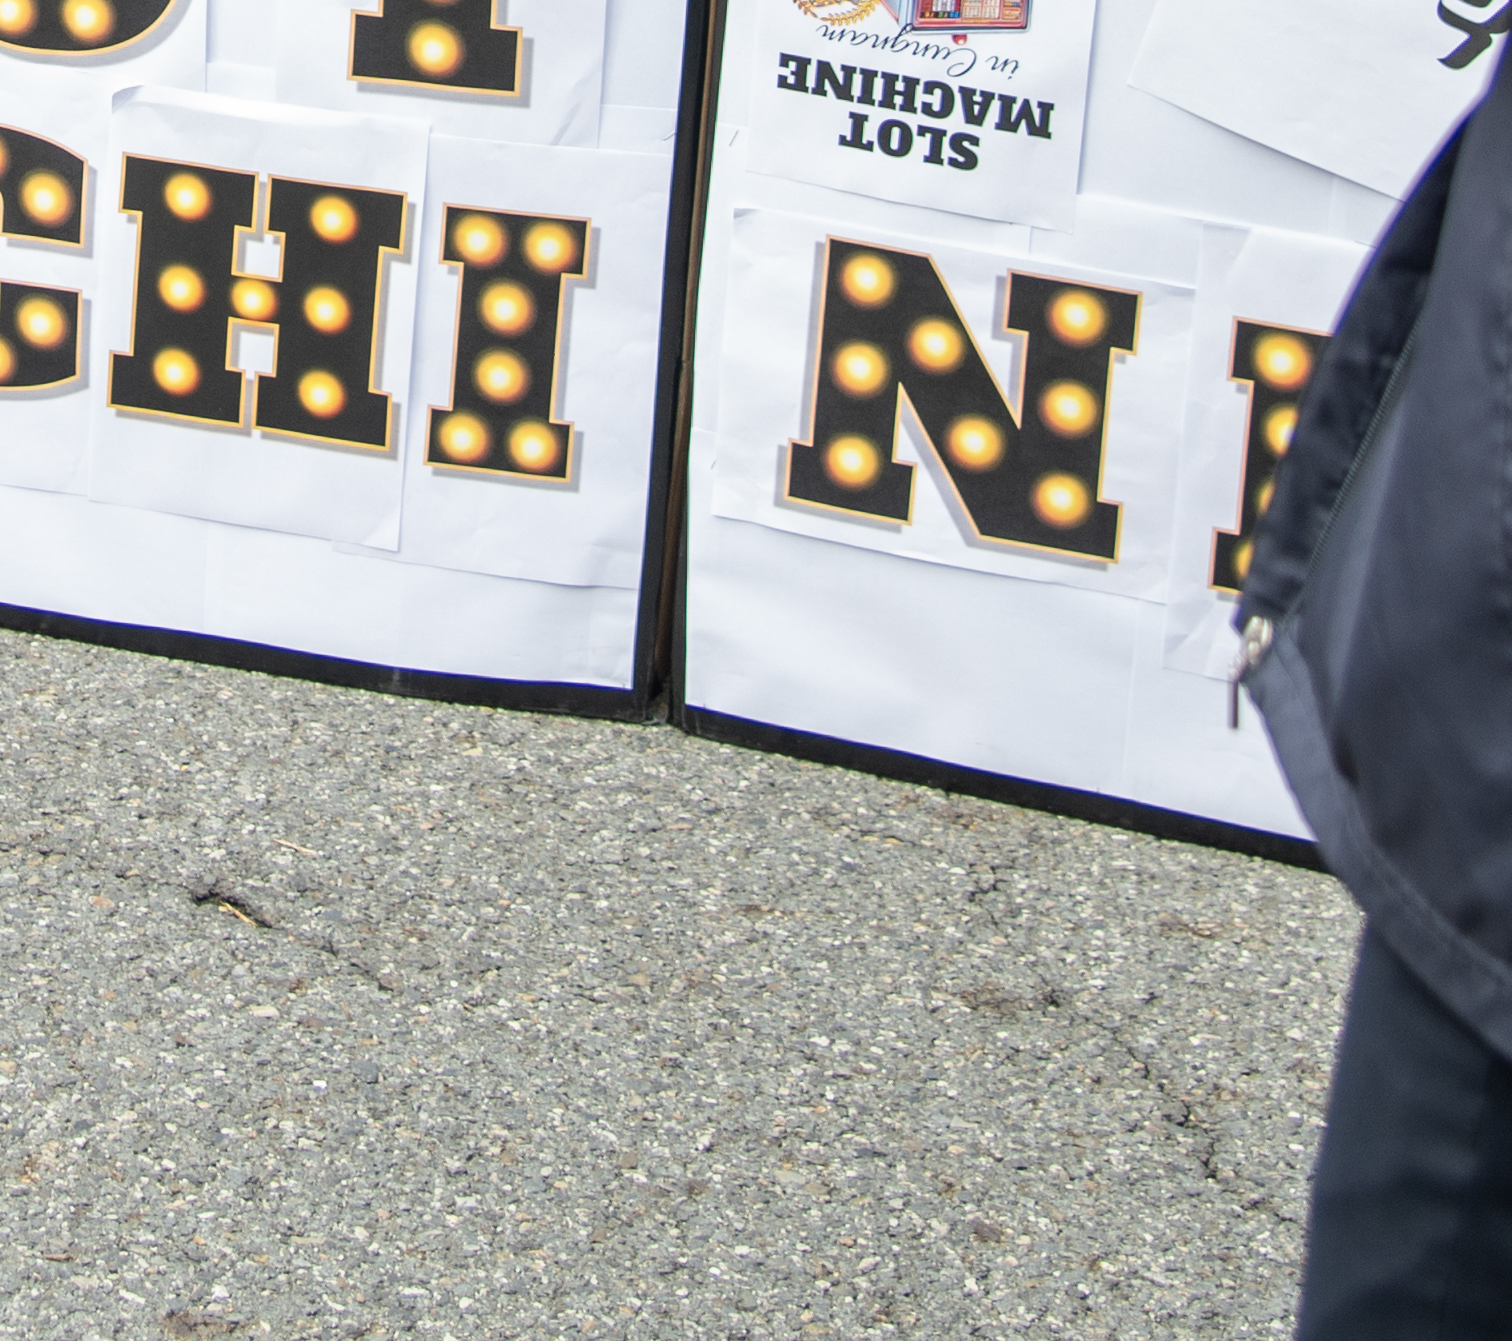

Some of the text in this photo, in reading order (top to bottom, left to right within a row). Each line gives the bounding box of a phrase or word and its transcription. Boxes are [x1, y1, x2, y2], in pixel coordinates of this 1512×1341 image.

[777, 51, 1055, 140] MACHINE
[986, 55, 1020, 80] in
[838, 111, 981, 172] SLOT
